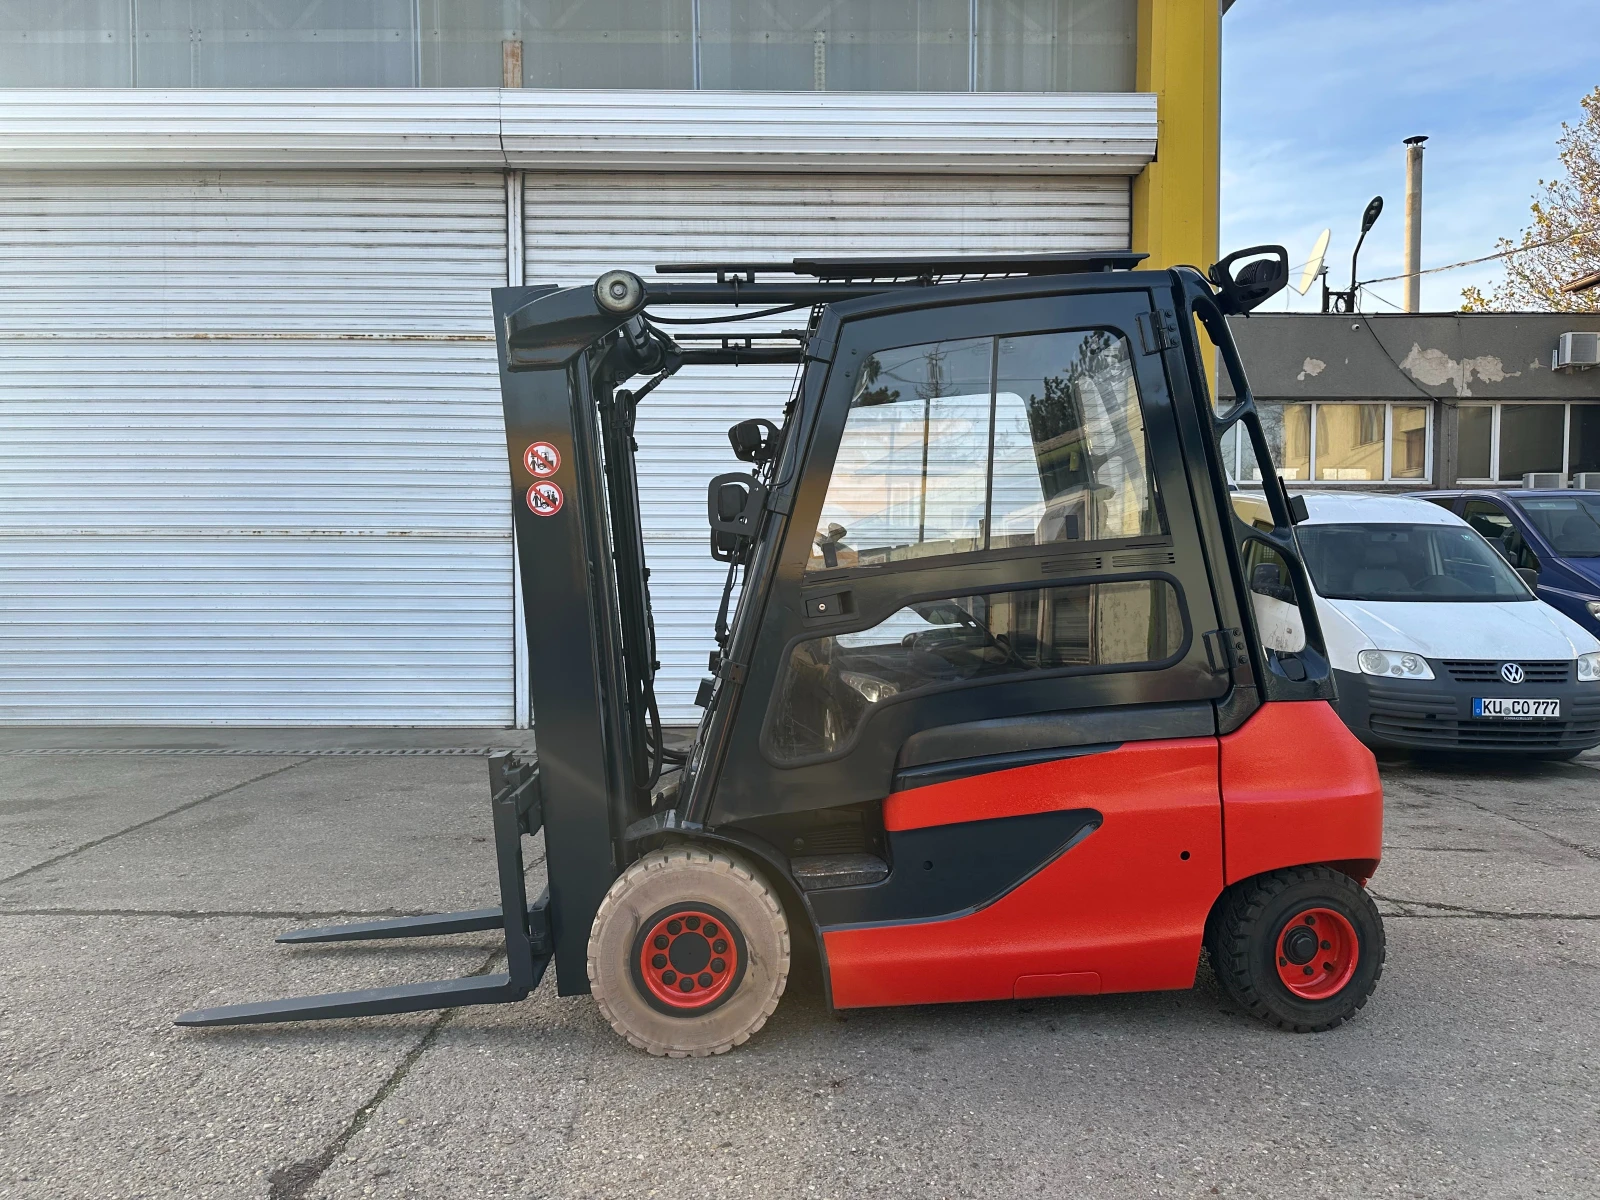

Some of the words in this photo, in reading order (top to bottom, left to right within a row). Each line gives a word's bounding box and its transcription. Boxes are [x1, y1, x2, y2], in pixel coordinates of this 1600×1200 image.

[1501, 663, 1524, 684] VW
[1483, 700, 1502, 715] KU
[1512, 700, 1530, 715] CO
[1533, 701, 1558, 715] 777
